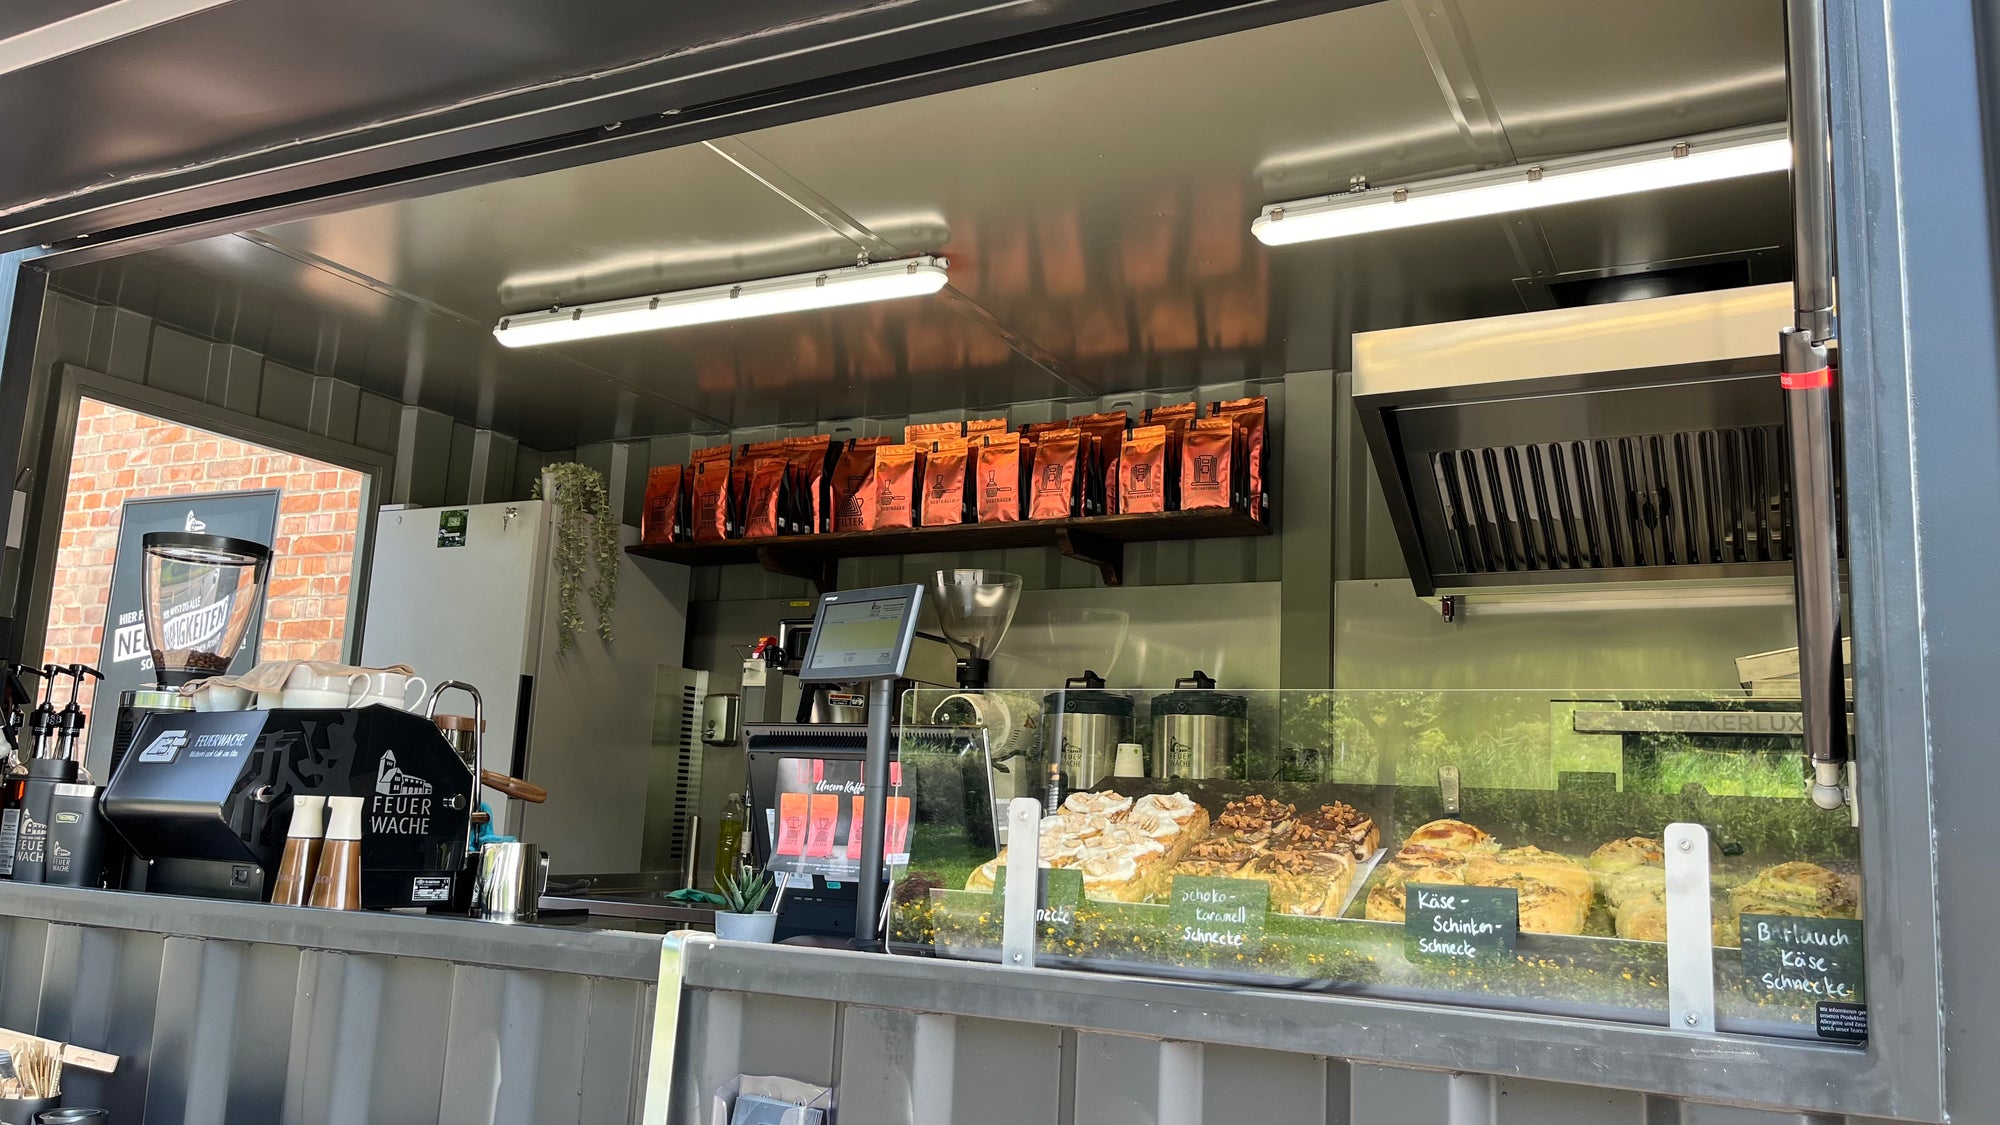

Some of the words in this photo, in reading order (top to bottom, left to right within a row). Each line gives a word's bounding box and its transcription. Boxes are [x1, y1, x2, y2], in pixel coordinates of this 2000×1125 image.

[837, 517, 864, 527] FILTER
[119, 612, 137, 626] HIER
[1671, 714, 1804, 732] BAKERLUX
[194, 733, 248, 747] FEUERWACHE
[816, 780, 844, 792] Unsere
[844, 781, 865, 795] Kaffe
[372, 796, 432, 816] FEUER
[370, 816, 431, 835] WACHE
[18, 839, 45, 851] FEUE
[16, 850, 45, 863] WACH
[1036, 907, 1071, 926] necke
[1183, 927, 1243, 946] Schnecke
[1419, 937, 1478, 959] Schnecke
[1761, 973, 1850, 997] Schnecke
